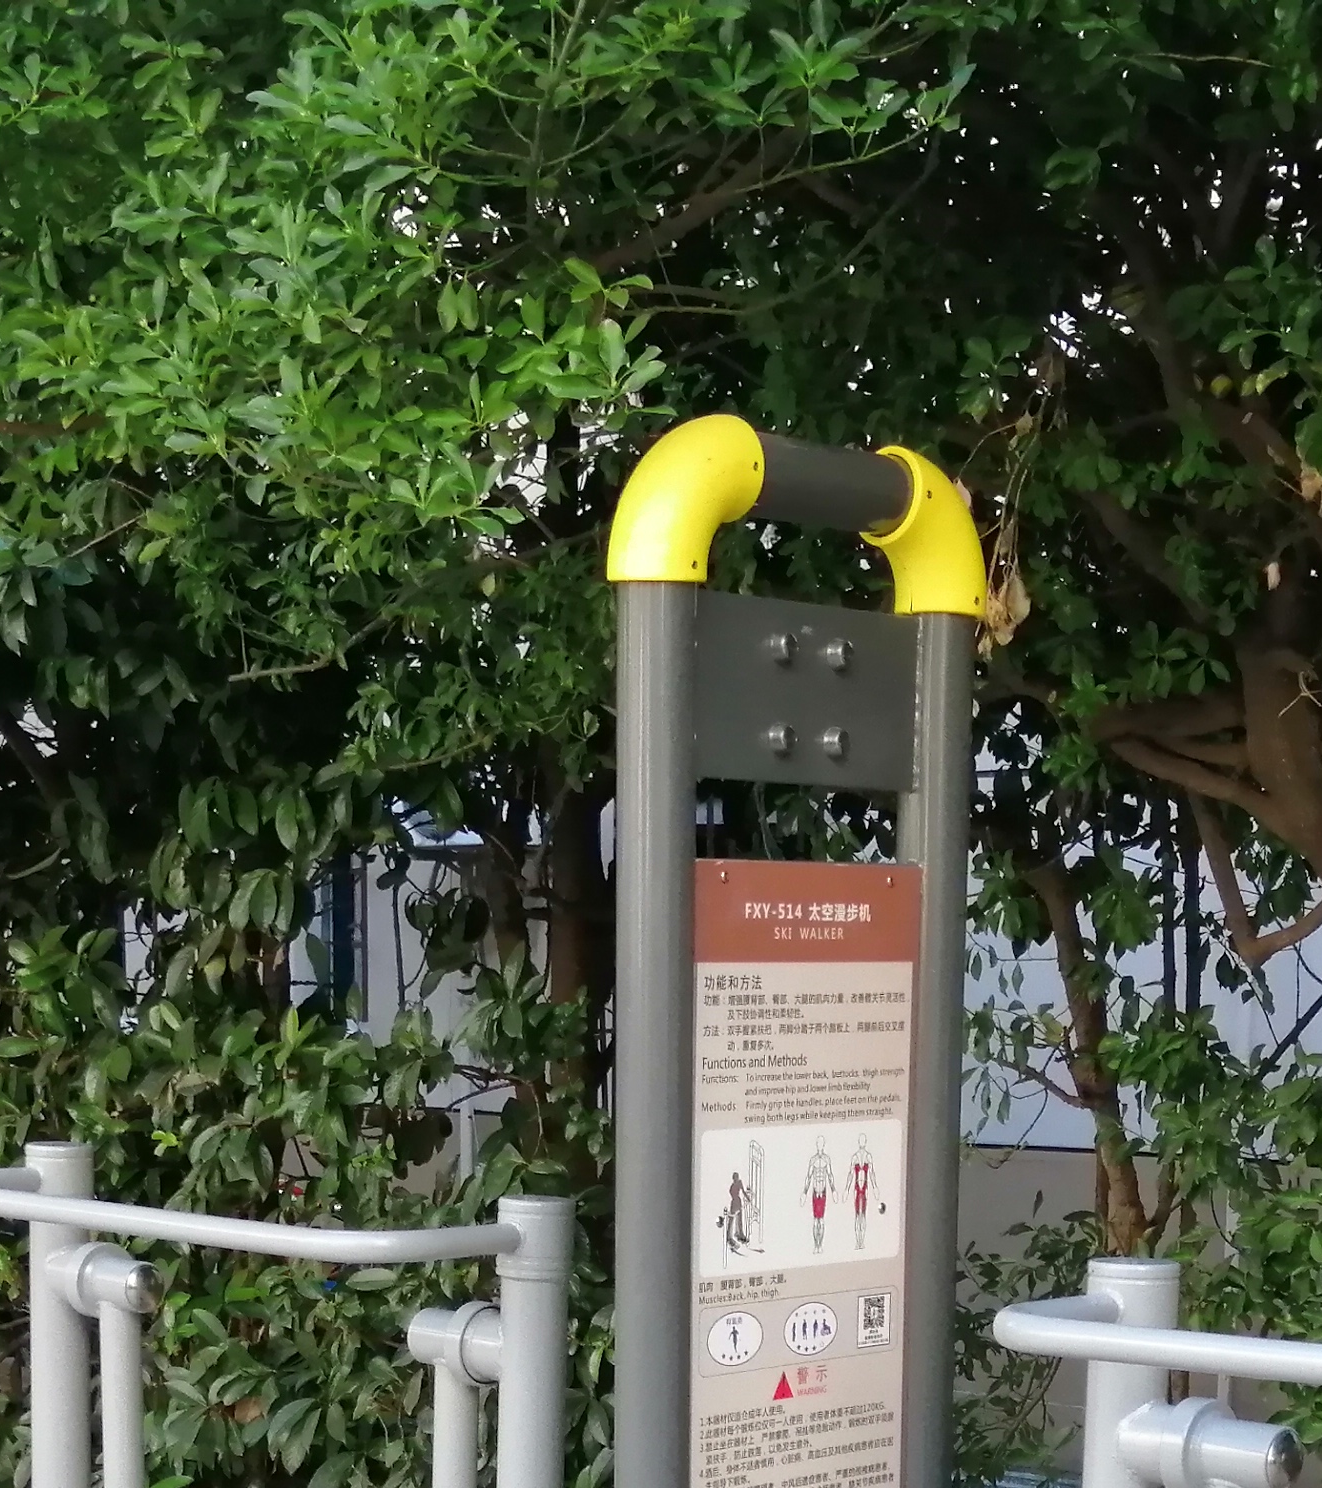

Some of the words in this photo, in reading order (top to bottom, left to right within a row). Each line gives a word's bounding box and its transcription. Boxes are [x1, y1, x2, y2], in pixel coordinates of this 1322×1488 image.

[745, 902, 802, 919] FXY-514
[808, 902, 870, 921] 太空漫步机
[774, 927, 791, 939] SKI
[799, 927, 843, 939] WALKER
[704, 974, 761, 990] 功能和方法
[702, 1055, 746, 1069] Functions
[748, 1055, 765, 1068] and
[768, 1053, 807, 1067] Methods
[782, 1071, 792, 1080] the
[745, 1086, 756, 1095] and
[785, 1084, 795, 1096] hip
[797, 1083, 808, 1093] and
[768, 1098, 782, 1110] grip
[784, 1097, 794, 1108] the
[824, 1095, 842, 1107] place
[857, 1094, 866, 1104] on
[867, 1093, 877, 1103] the
[744, 1113, 765, 1125] swing
[766, 1112, 783, 1121] both
[785, 1111, 798, 1123] legs
[799, 1110, 818, 1119] while
[819, 1109, 846, 1121] keeping
[847, 1107, 864, 1116] them
